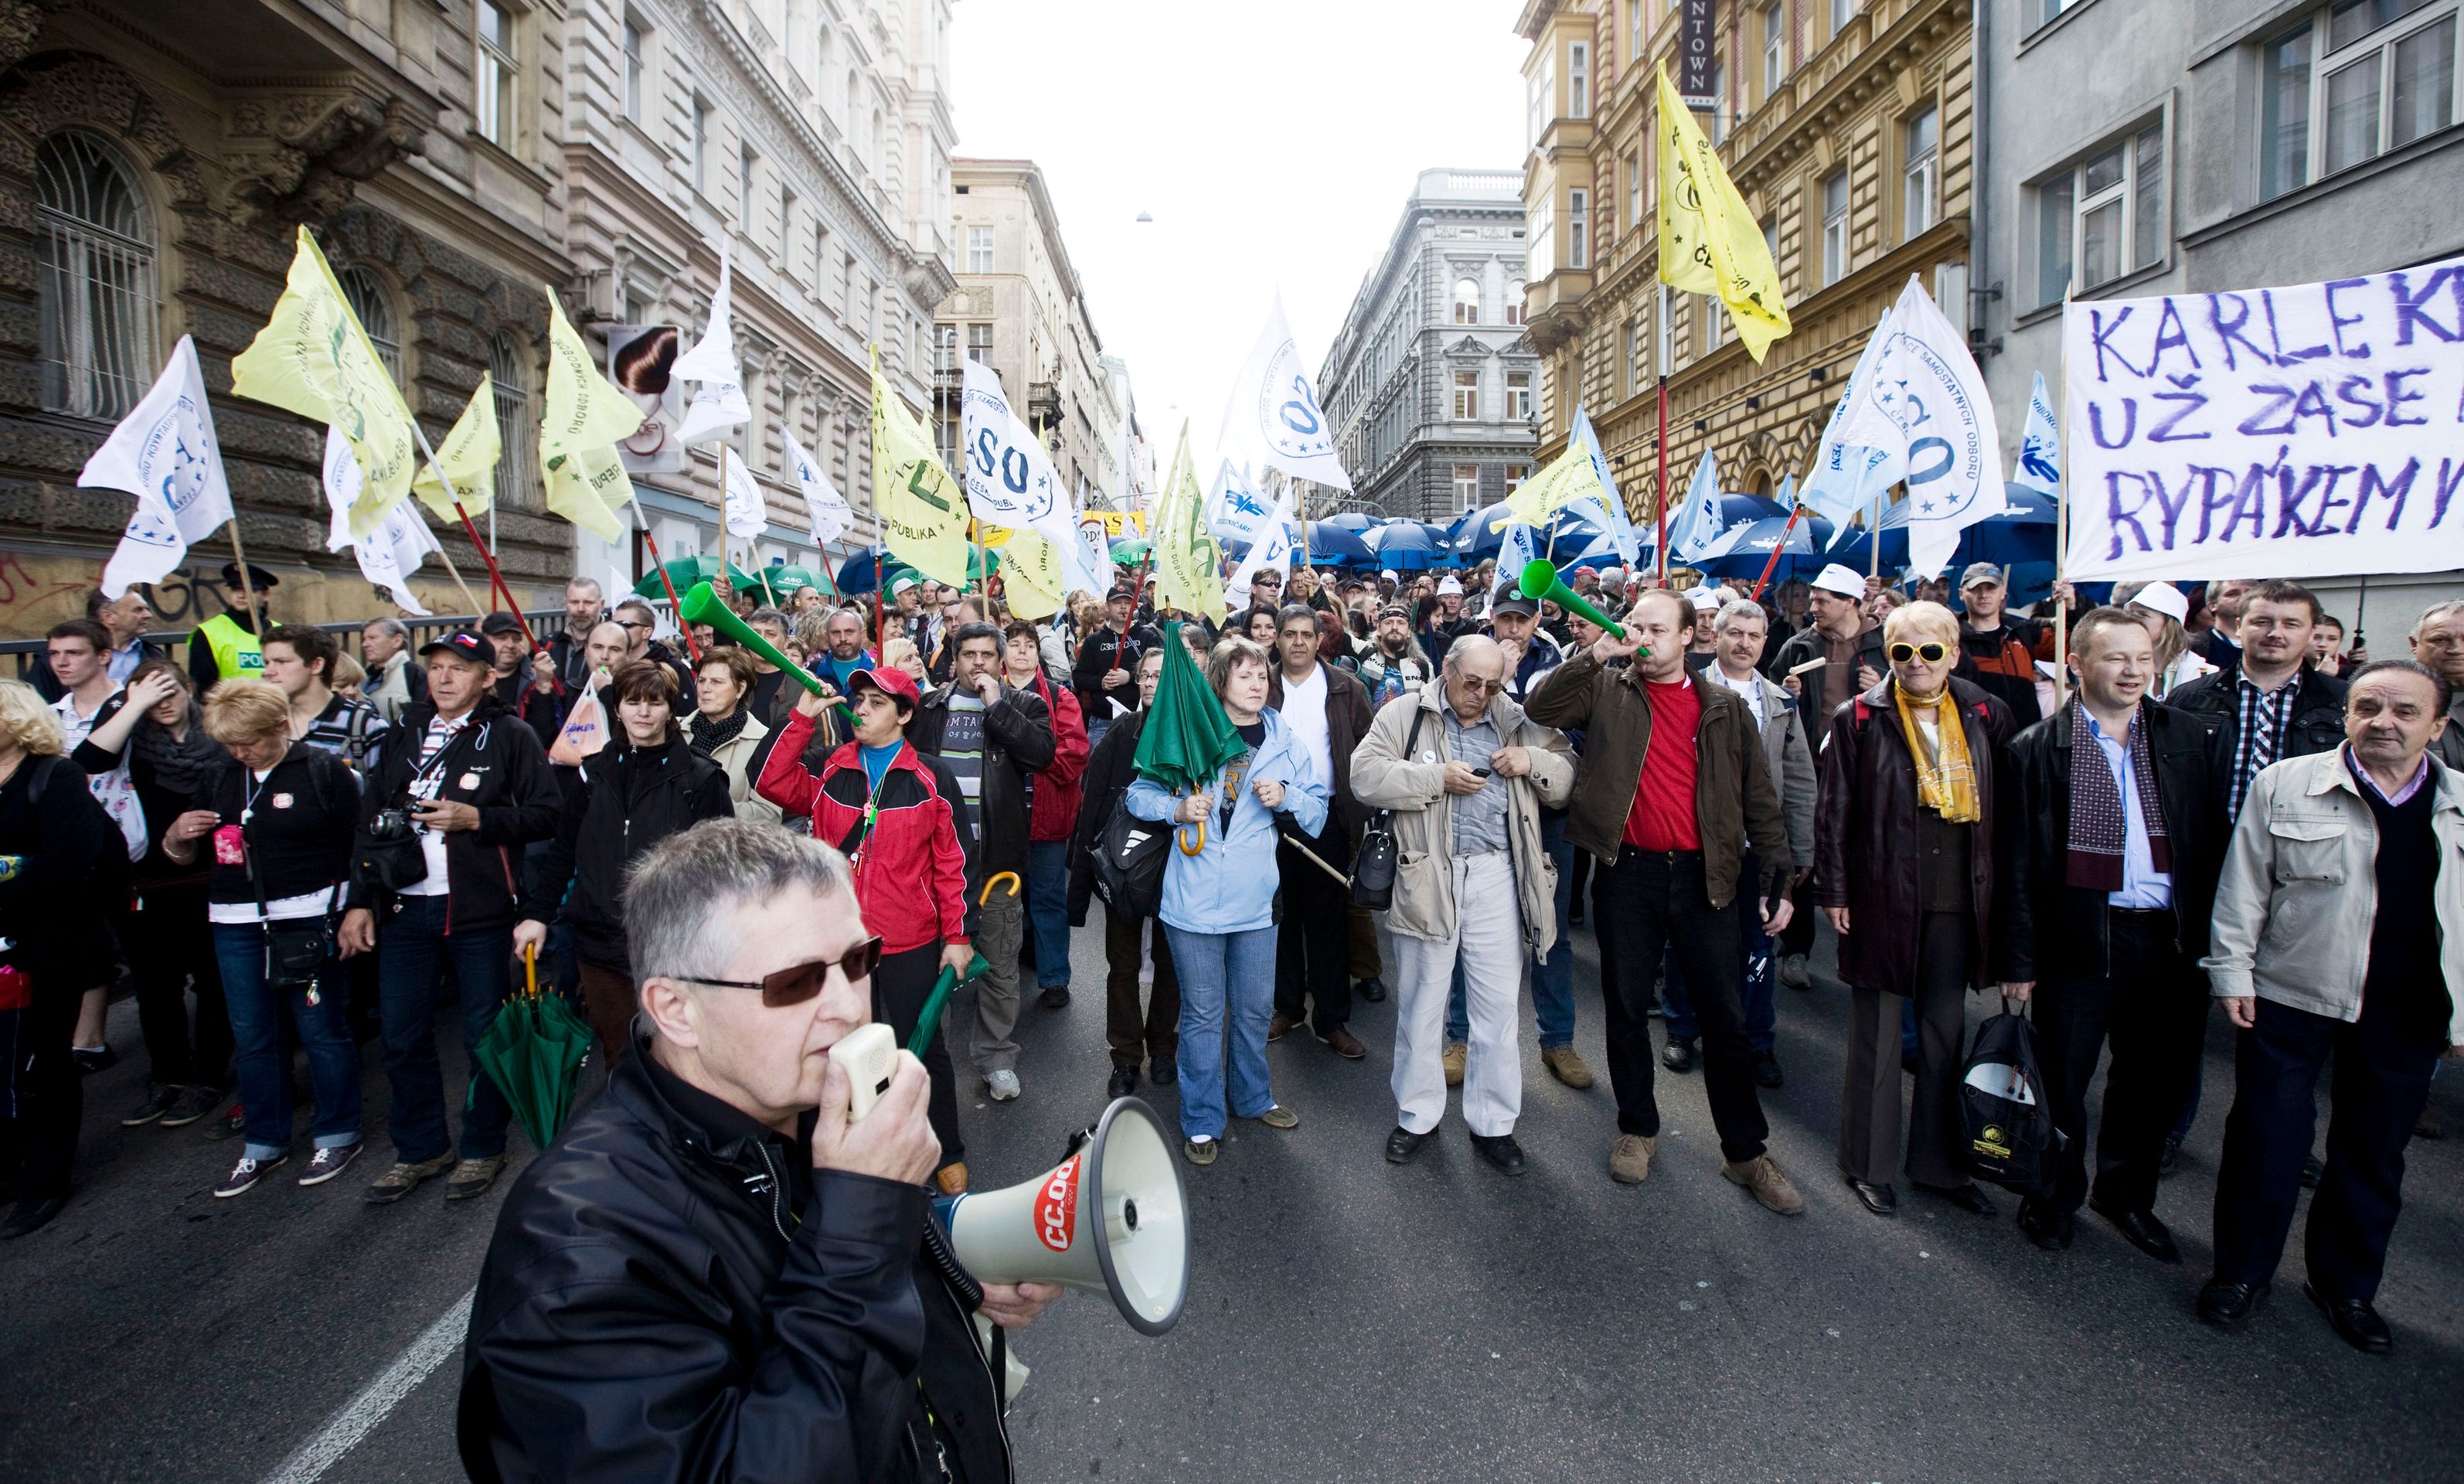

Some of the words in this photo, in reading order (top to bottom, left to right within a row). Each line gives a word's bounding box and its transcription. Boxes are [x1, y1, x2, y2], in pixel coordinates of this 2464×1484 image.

[2088, 373, 2212, 450] UŽ
[2237, 367, 2432, 438] ZASE
[1965, 432, 1979, 481] ODBORŮ
[890, 519, 938, 540] PUBLIKA
